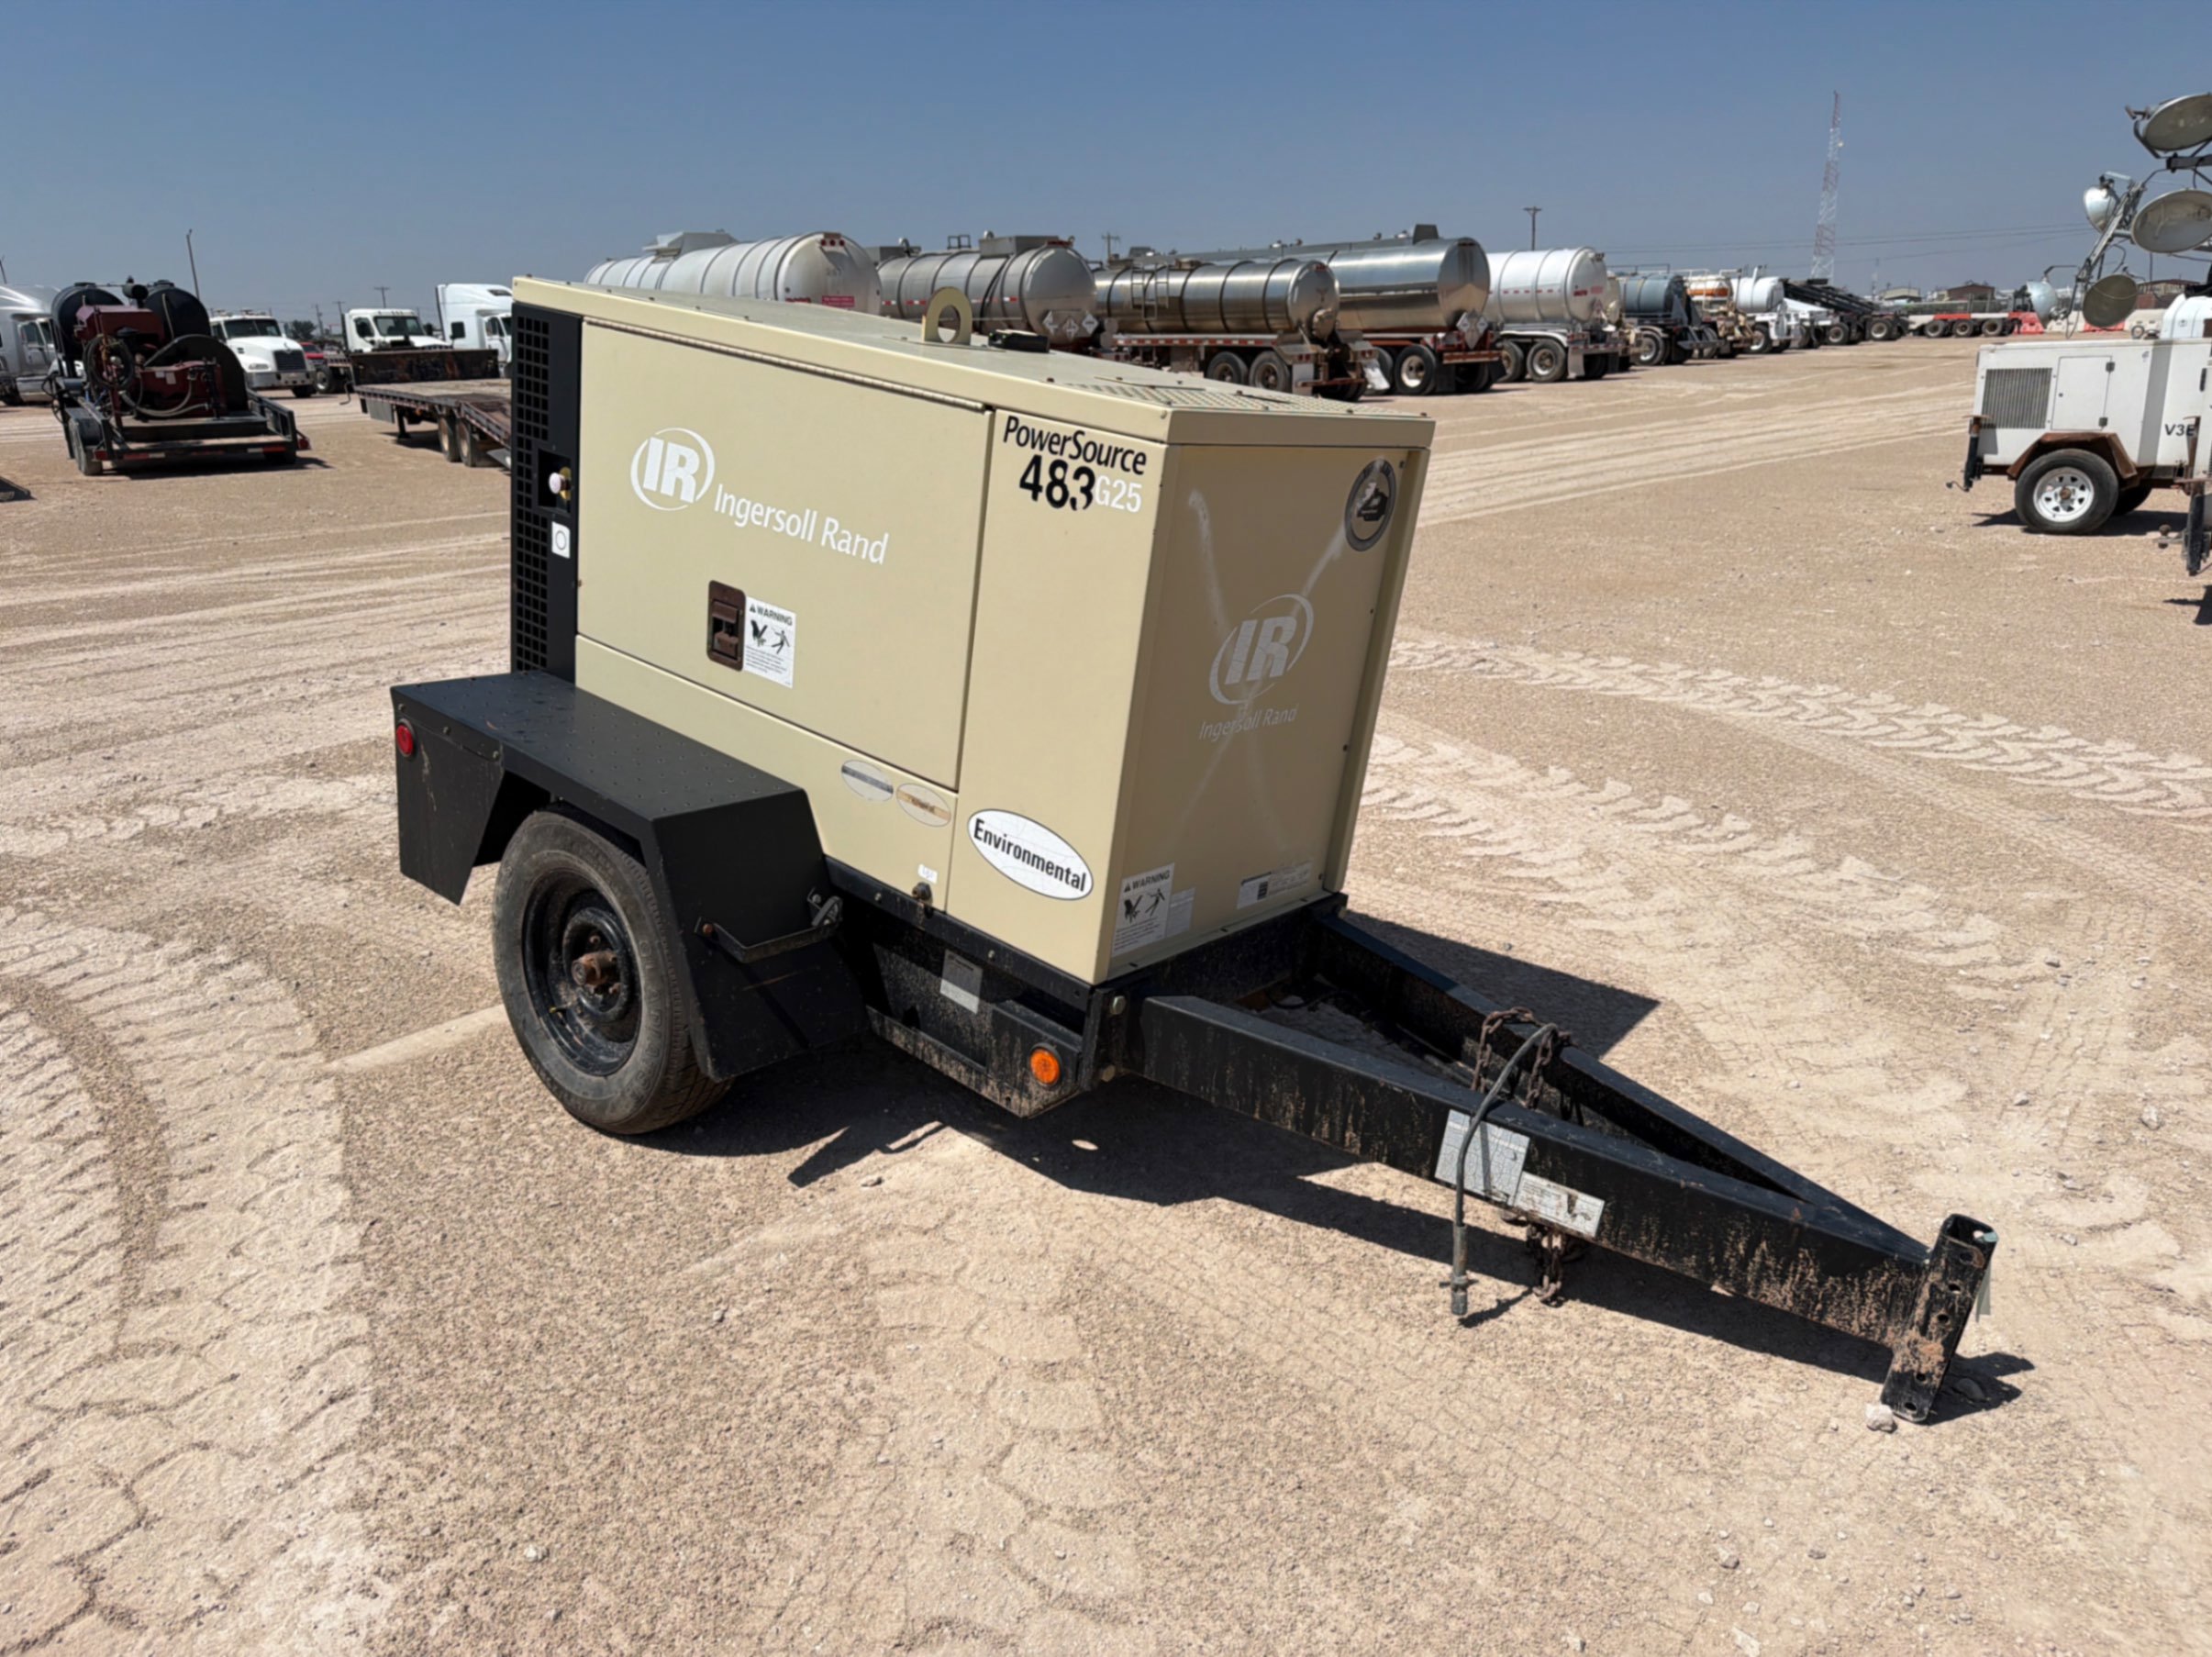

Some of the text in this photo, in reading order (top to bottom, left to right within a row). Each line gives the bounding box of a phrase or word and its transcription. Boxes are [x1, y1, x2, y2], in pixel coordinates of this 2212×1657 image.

[643, 436, 701, 506] IR
[1003, 416, 1148, 475] PowerSource
[713, 484, 889, 566] Ingersoll Rand
[755, 606, 794, 627] WARNING
[1224, 615, 1297, 685] IR
[1198, 704, 1299, 742] Ingersoll Rand
[973, 818, 1086, 893] Environmental
[1131, 870, 1171, 890] WARNING
